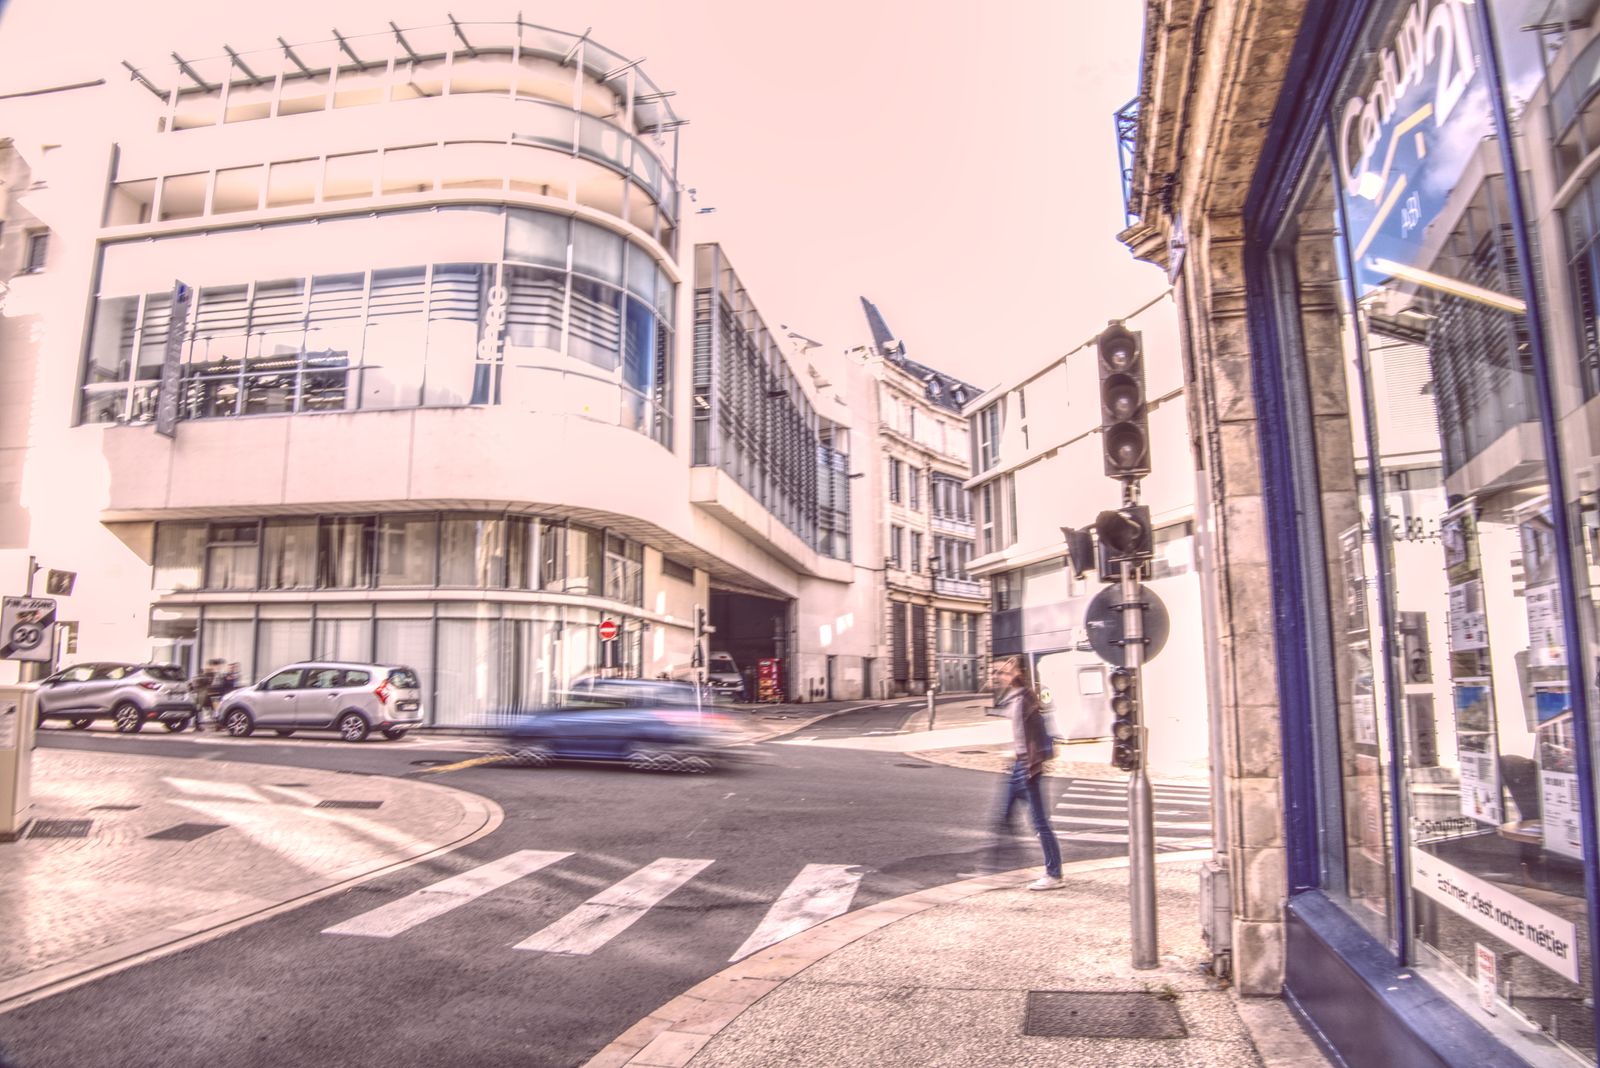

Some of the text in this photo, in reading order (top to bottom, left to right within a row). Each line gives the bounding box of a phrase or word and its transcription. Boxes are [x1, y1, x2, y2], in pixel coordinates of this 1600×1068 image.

[1425, 0, 1475, 128] 21
[15, 628, 39, 644] 30
[1495, 907, 1525, 936] notre
[1526, 924, 1569, 959] métier
